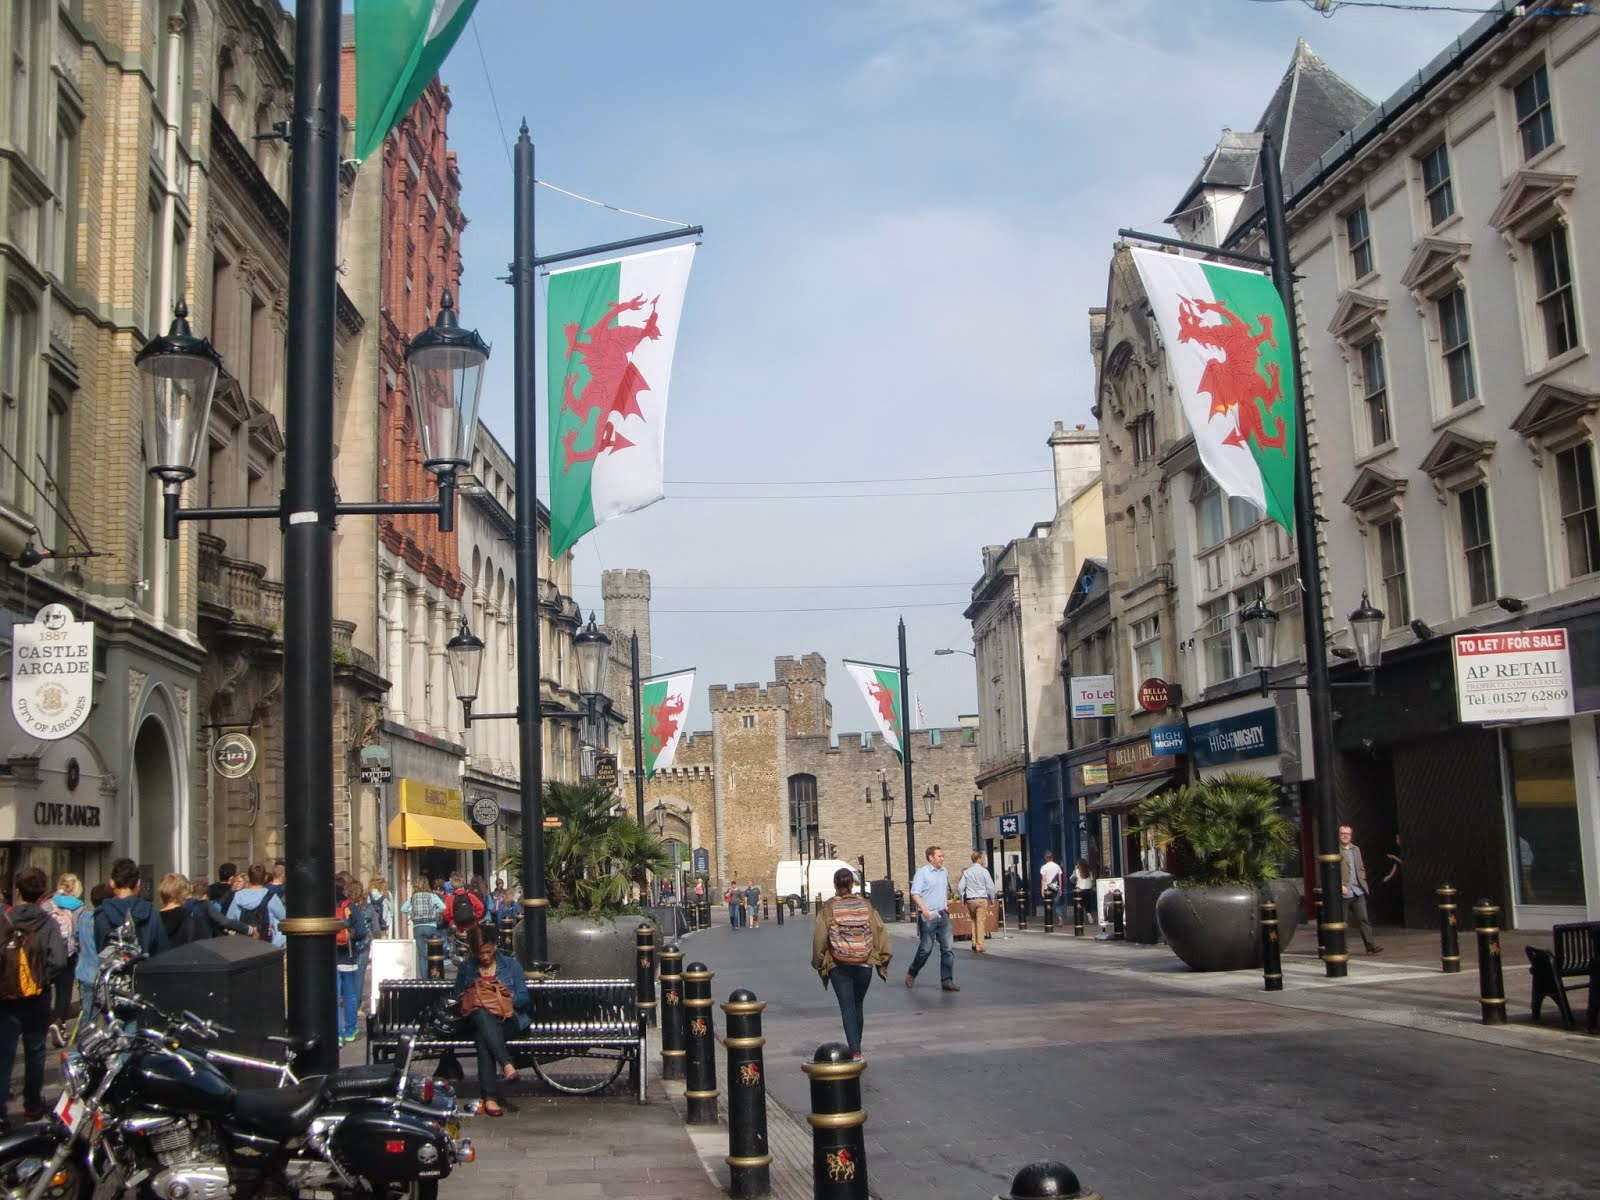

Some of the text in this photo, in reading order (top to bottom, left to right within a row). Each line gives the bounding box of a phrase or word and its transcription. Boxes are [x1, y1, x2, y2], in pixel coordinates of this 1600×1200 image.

[40, 632, 68, 641] 1887
[1460, 640, 1475, 653] TO
[1478, 638, 1499, 652] LET
[1507, 636, 1531, 650] FOR
[1533, 634, 1563, 648] SALE
[18, 645, 88, 659] CASTLE
[17, 661, 89, 675] ARCADE
[1466, 661, 1562, 680] AP RETAIL
[1143, 687, 1167, 695] BELLA
[1466, 681, 1505, 691] PROPERTY
[1080, 690, 1115, 700] To Let
[1142, 694, 1169, 702] ITALIA
[1492, 691, 1527, 704] 01527
[1531, 688, 1569, 702] 62869
[18, 695, 86, 733] CITY OF ARCADES
[1154, 731, 1181, 741] HIGH
[1232, 725, 1264, 748] MIGHTY
[1155, 739, 1184, 749] MIGHTY
[218, 750, 248, 761] Zizzi
[1115, 747, 1137, 766] BELLA
[34, 801, 64, 826] CLIVE
